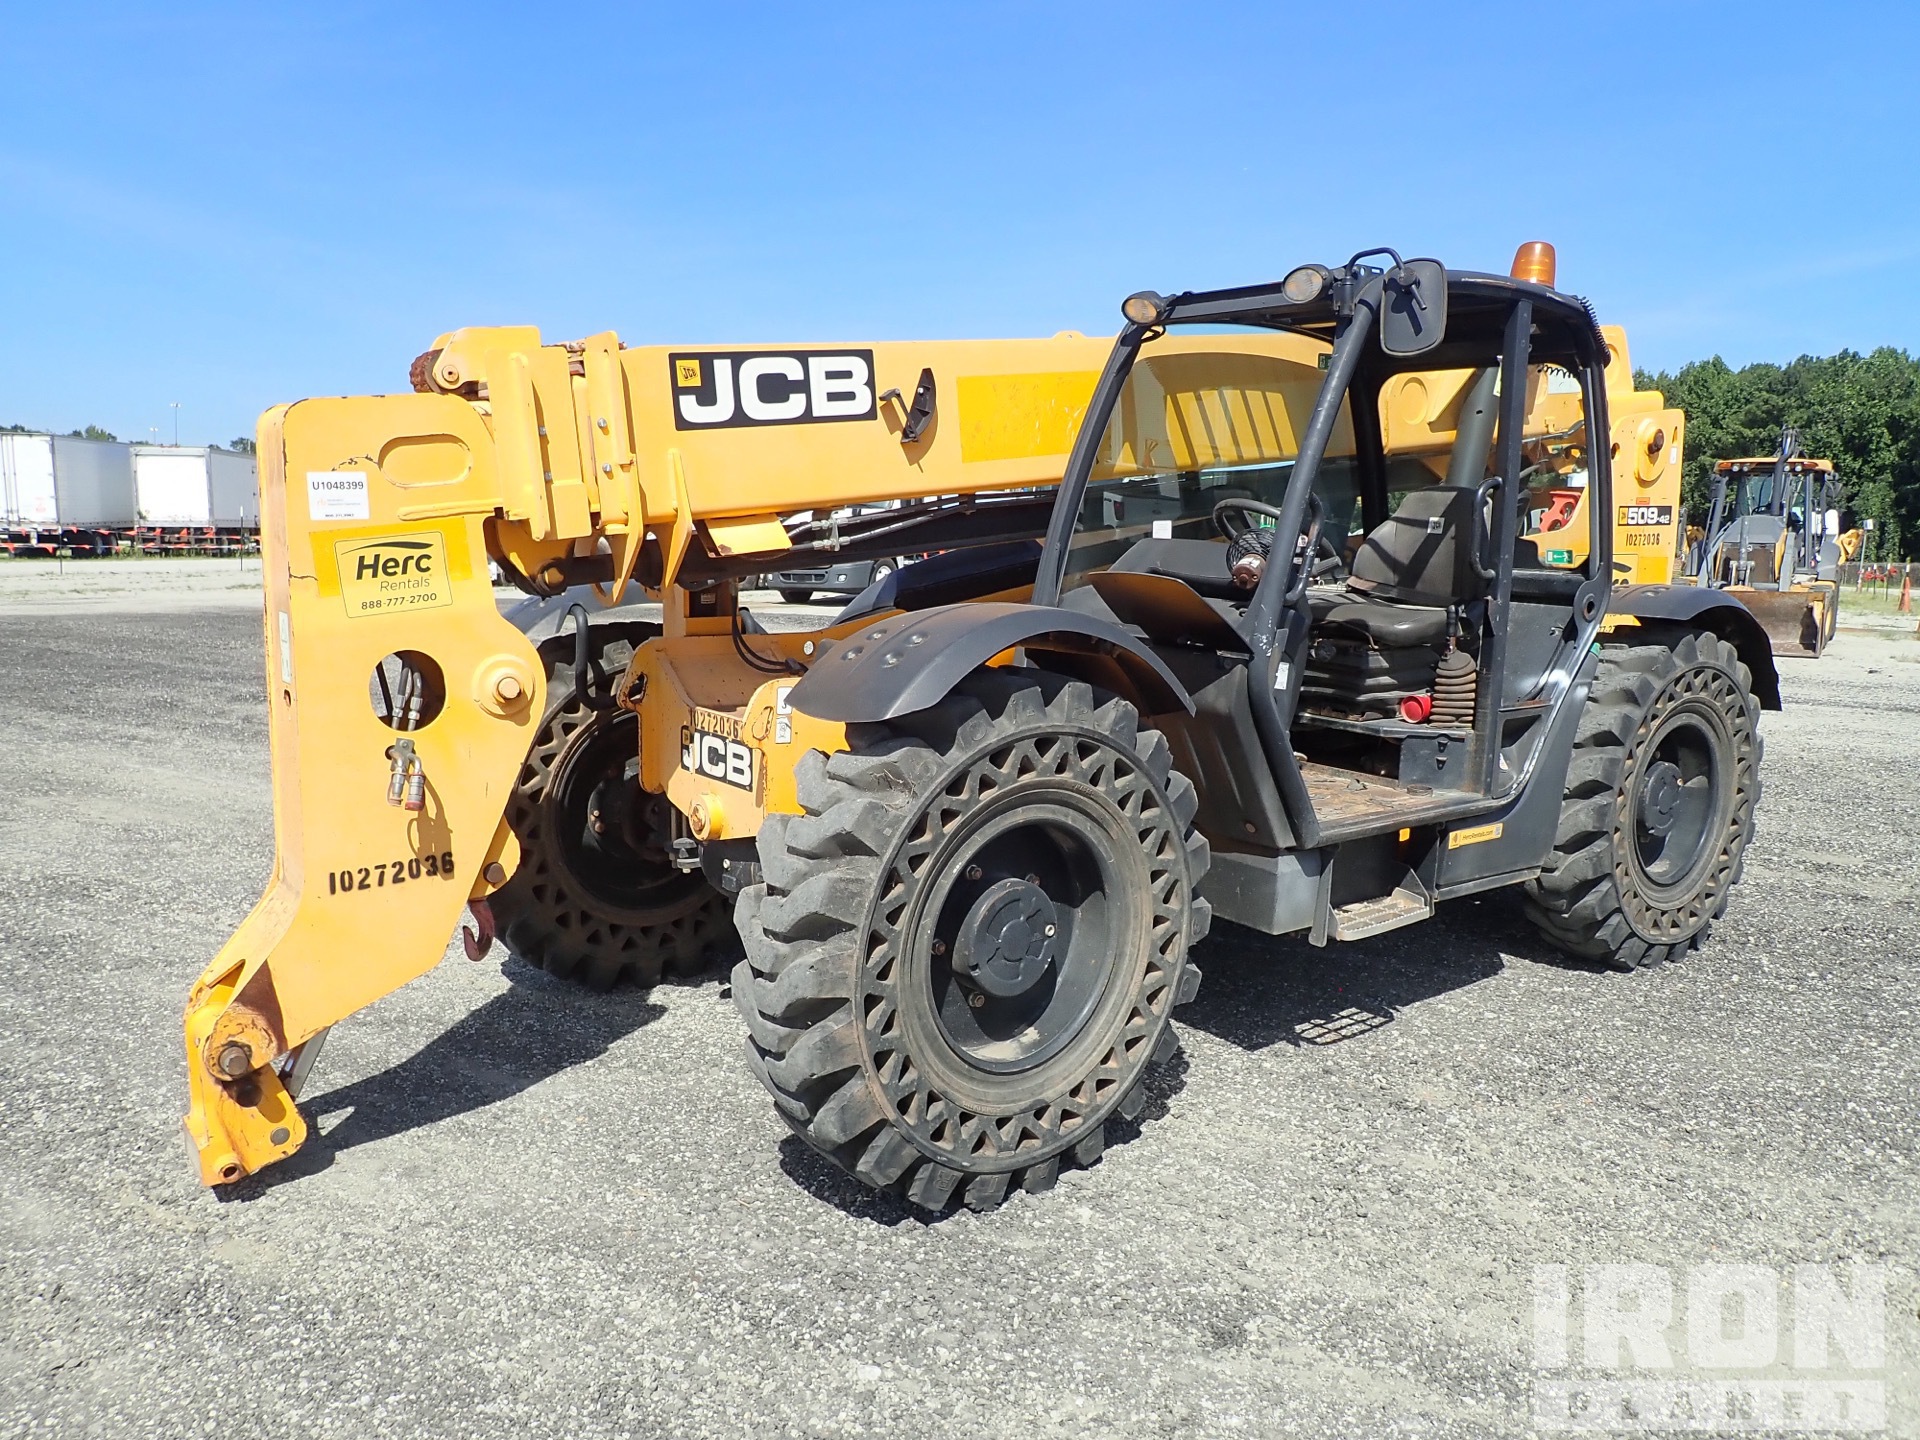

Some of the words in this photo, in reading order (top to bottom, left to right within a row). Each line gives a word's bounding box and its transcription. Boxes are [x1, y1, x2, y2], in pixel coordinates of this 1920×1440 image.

[682, 366, 697, 380] JCB
[679, 356, 872, 423] JCB
[312, 481, 364, 490] U1048399
[1626, 533, 1660, 546] 10272036
[356, 553, 433, 581] Herc
[380, 576, 430, 592] Rentals
[361, 593, 437, 610] 888-777-2700
[682, 732, 752, 786] JCB
[329, 851, 455, 895] 10272036
